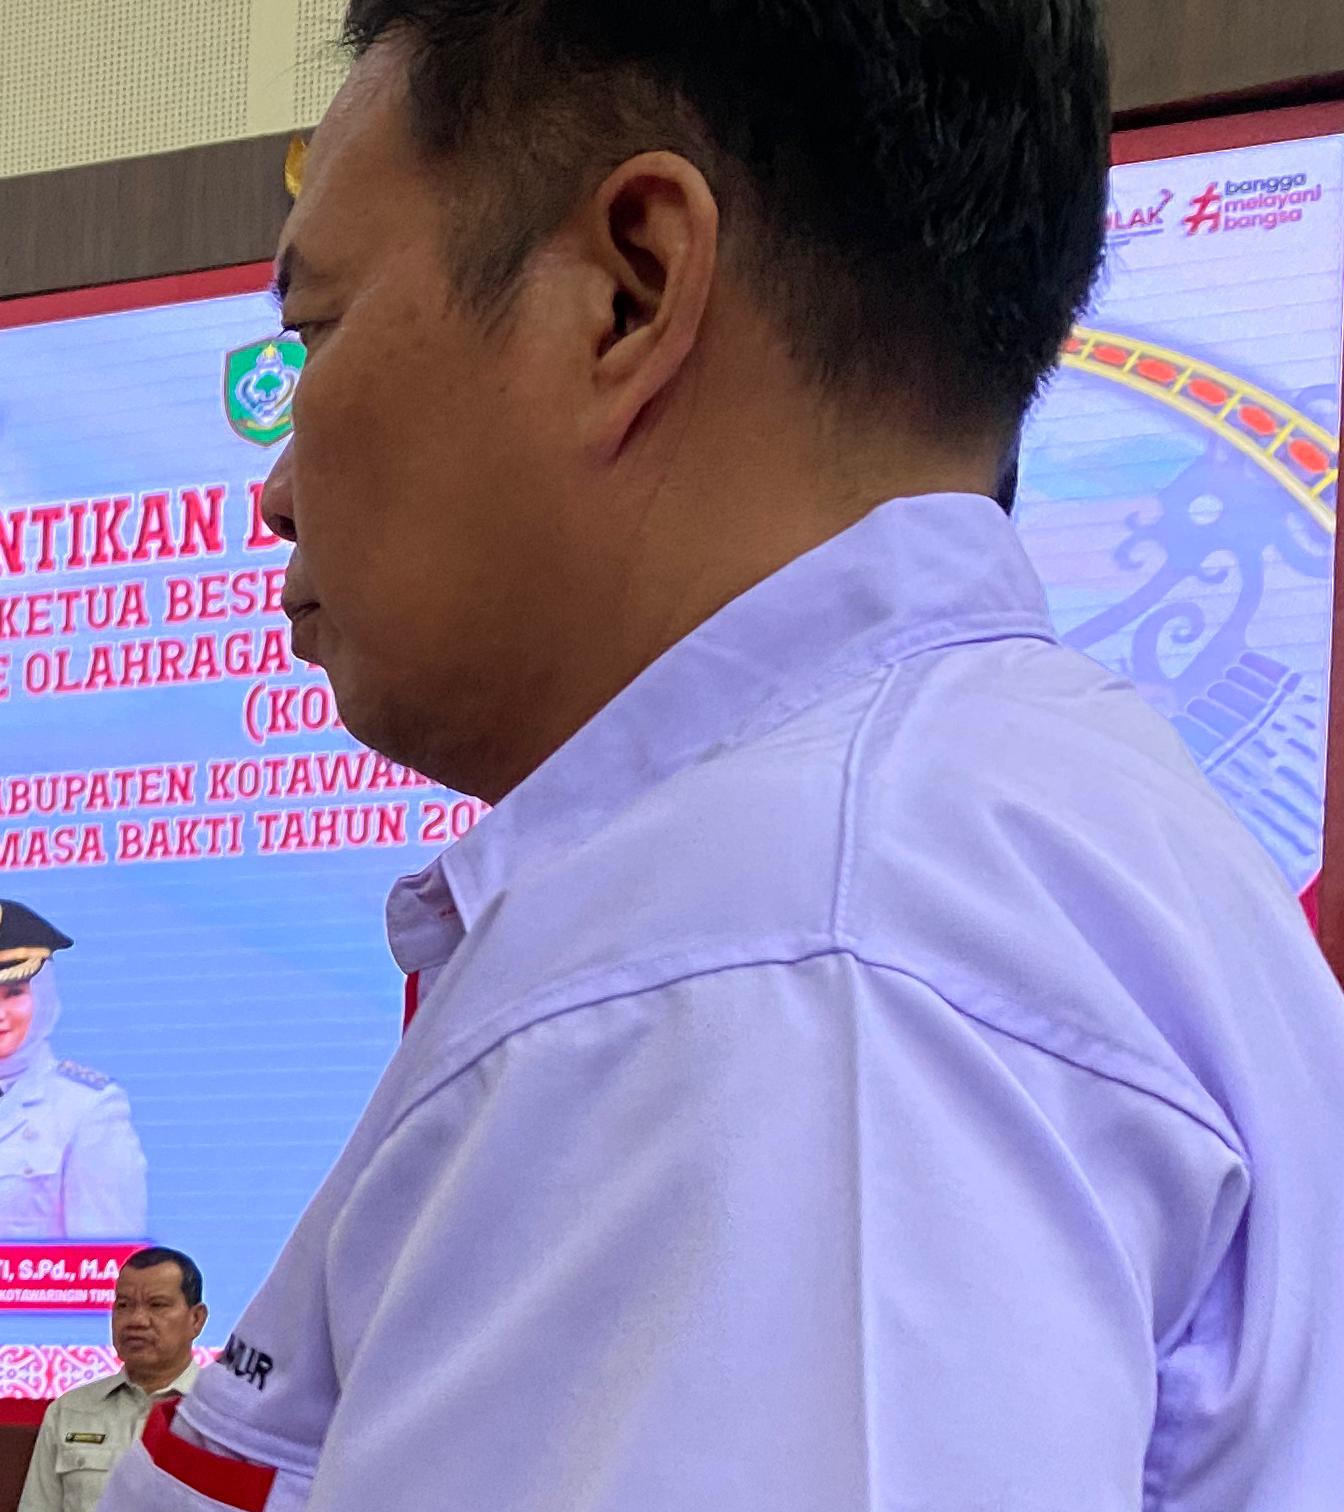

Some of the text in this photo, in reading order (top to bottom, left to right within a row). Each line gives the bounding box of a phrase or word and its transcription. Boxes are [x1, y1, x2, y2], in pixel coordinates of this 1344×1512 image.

[1105, 189, 1173, 229] LAK
[1225, 173, 1306, 196] bangga
[1224, 209, 1302, 231] bangsa
[25, 628, 291, 696] OLAHRAGA
[245, 681, 345, 744] (KO
[119, 815, 244, 860] BAKTI
[258, 802, 407, 850] TAHUN
[422, 800, 490, 842] 20
